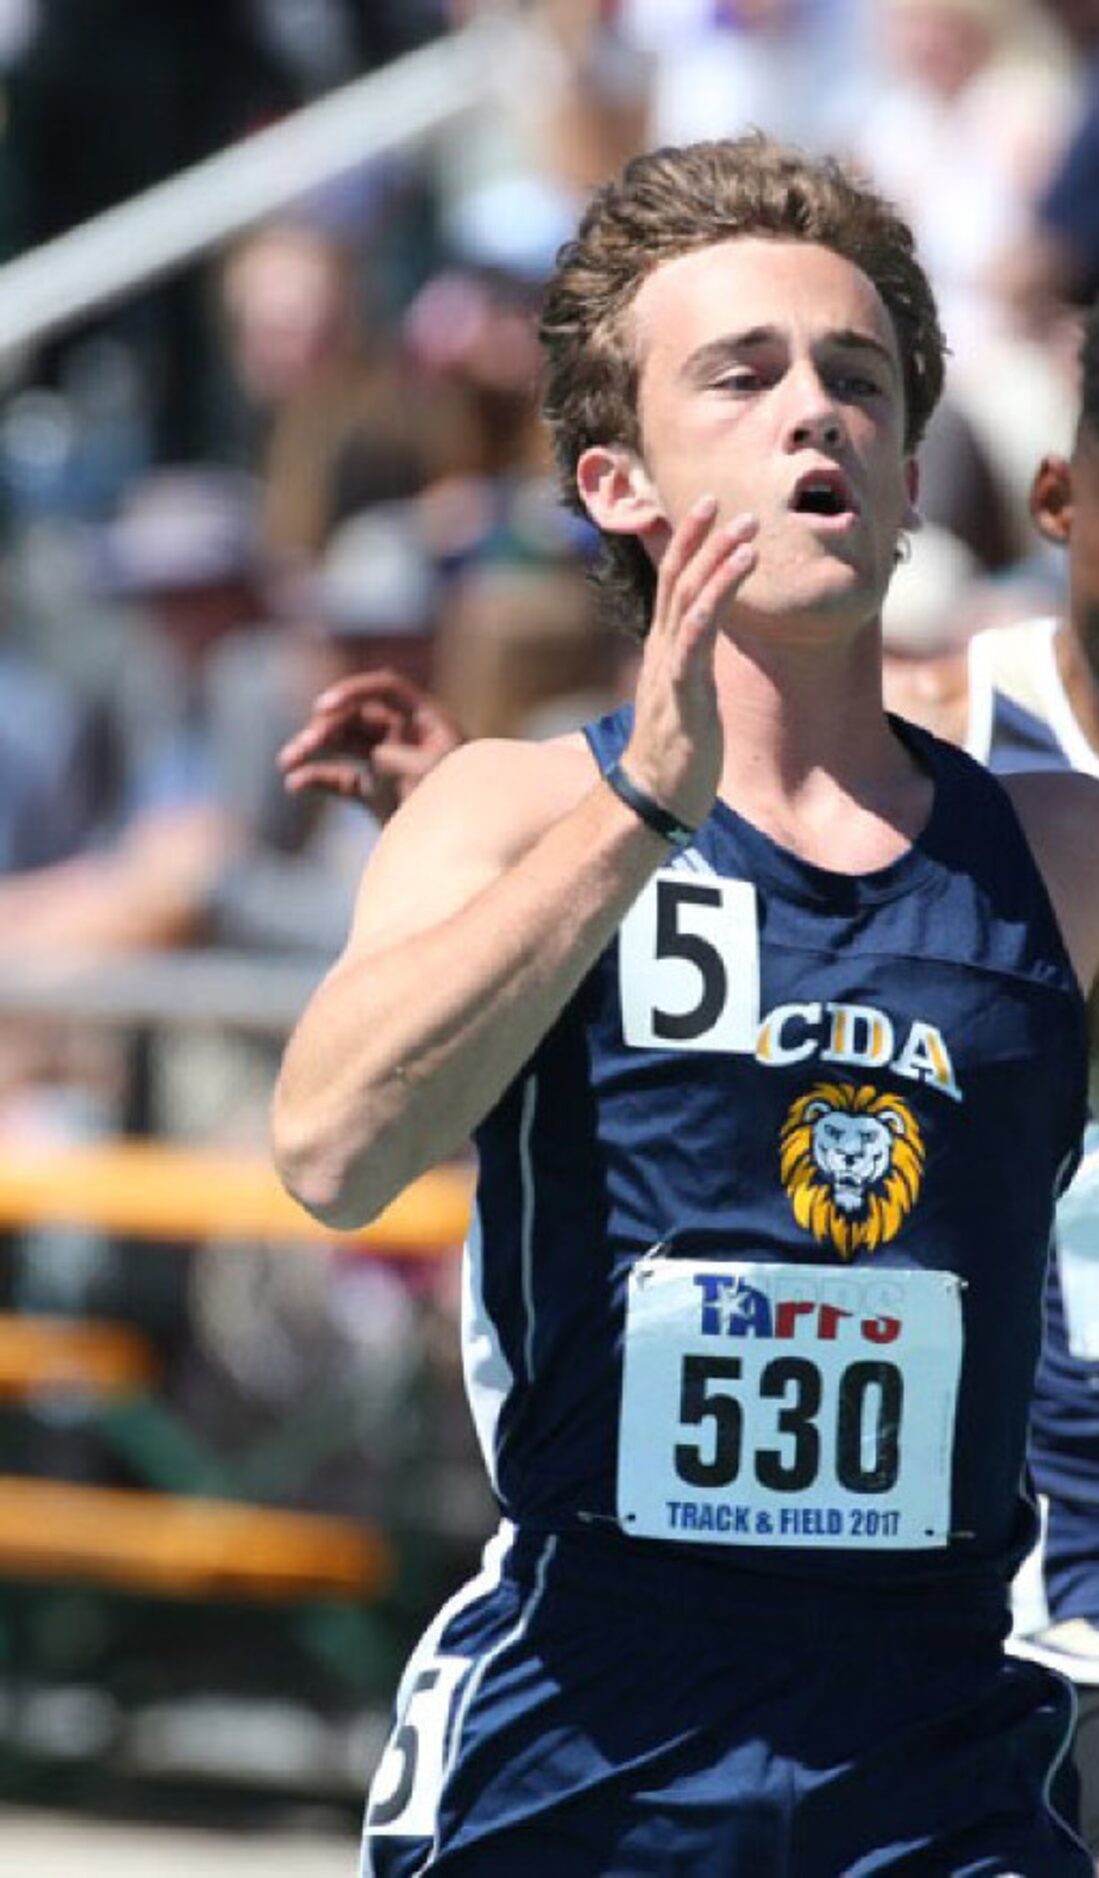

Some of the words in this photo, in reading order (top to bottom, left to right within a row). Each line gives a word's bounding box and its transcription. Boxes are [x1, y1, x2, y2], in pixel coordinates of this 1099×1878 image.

[651, 881, 727, 1040] 5
[755, 1002, 963, 1101] CDA
[674, 1354, 904, 1494] 530
[667, 1502, 750, 1532] TRACK
[755, 1511, 773, 1534] &
[780, 1508, 842, 1535] FIELD
[851, 1509, 900, 1537] 2017
[370, 1669, 441, 1827] 5
